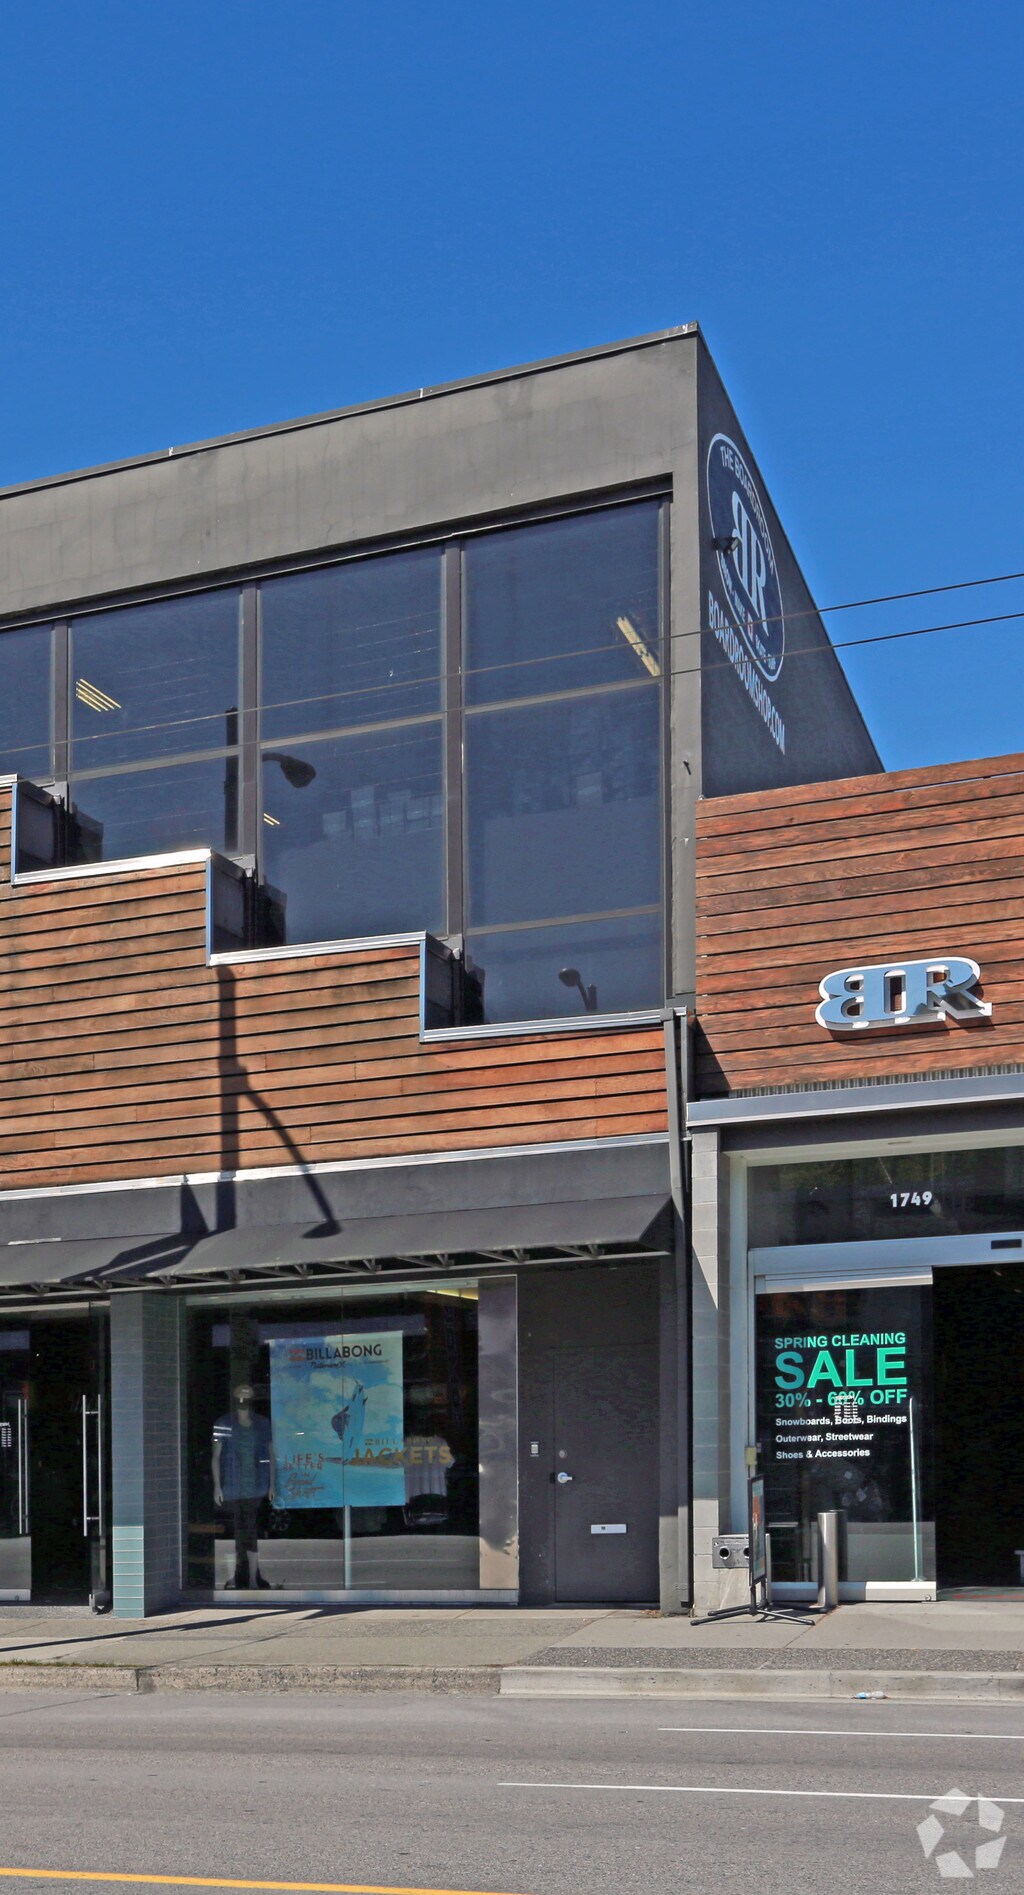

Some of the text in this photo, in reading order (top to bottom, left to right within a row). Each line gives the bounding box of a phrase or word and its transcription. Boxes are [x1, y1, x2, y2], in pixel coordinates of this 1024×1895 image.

[720, 446, 734, 471] THE
[890, 1191, 933, 1208] 1749
[775, 1332, 906, 1349] SPRING CLEANING
[306, 1344, 382, 1361] BILLABONG
[775, 1346, 907, 1390] SALE
[775, 1392, 811, 1408] 30%
[870, 1389, 908, 1405] OFF
[776, 1417, 833, 1426] Snowboards,
[867, 1415, 908, 1424] Bindings
[776, 1432, 874, 1443] Outerwear, Streetwear
[351, 1446, 452, 1466] JACKETS
[776, 1448, 871, 1459] Shoes & Accessories
